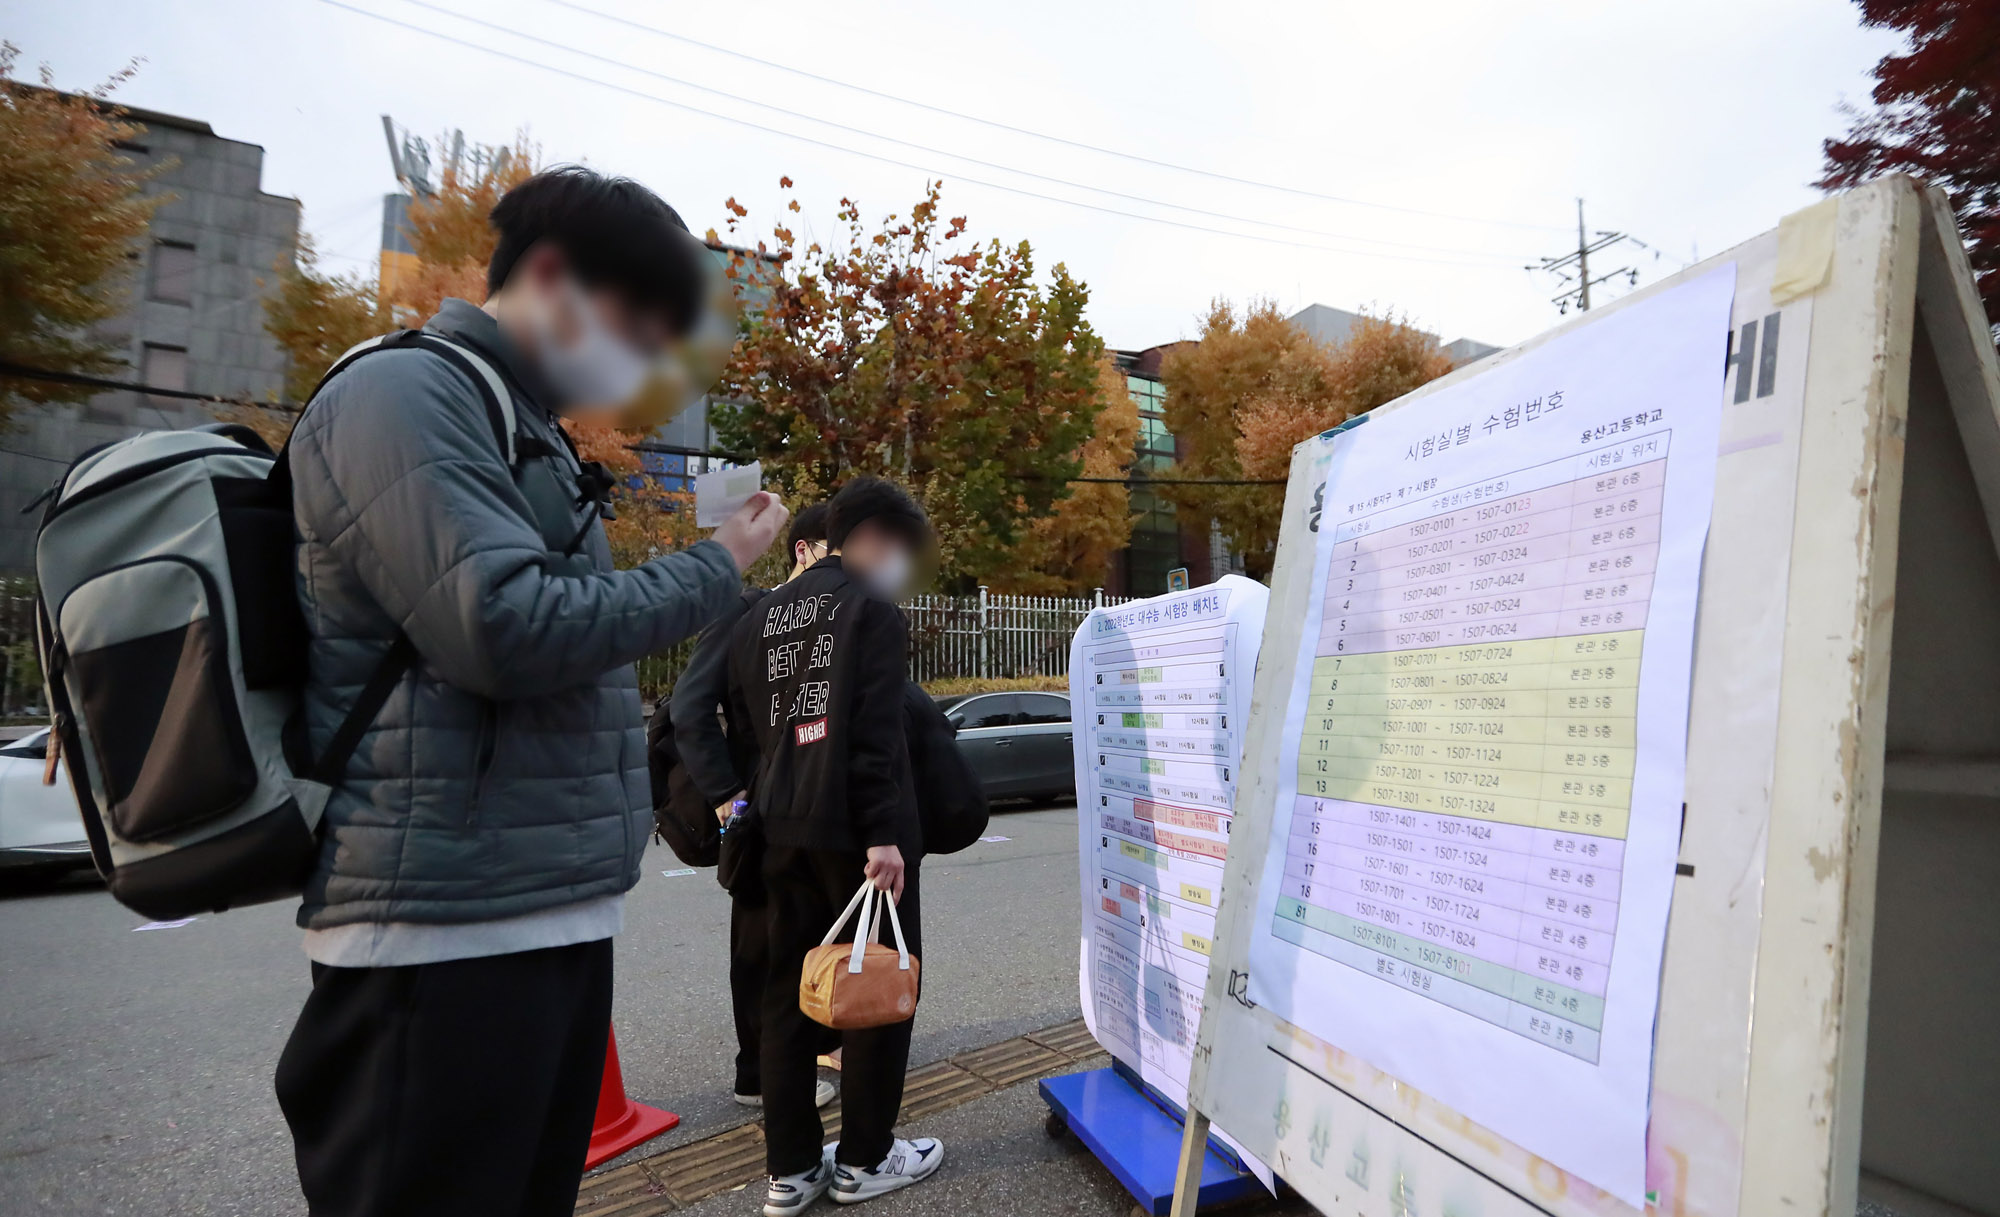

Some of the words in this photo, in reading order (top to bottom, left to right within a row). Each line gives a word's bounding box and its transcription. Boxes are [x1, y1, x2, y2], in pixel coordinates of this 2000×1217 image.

[1405, 423, 1471, 461] 시험실별
[1482, 391, 1564, 435] 수험번호
[1581, 409, 1663, 444] 용산고등학교
[1586, 448, 1624, 468] 시험실
[1632, 440, 1657, 457] 위치
[1354, 542, 1359, 551] 1
[1410, 518, 1454, 536] 1507-0101
[1476, 498, 1531, 522] 1507-0123
[1595, 478, 1617, 492] 본관
[1623, 472, 1640, 486] 6층
[1358, 502, 1364, 511] 15
[1408, 487, 1412, 495] 7
[1347, 580, 1353, 590] 3
[1406, 562, 1451, 579] 1507-0301
[1474, 547, 1527, 567] 1507-0324
[1591, 531, 1613, 545] 본관
[1619, 527, 1636, 539] 6층
[1351, 560, 1356, 571] 2
[1408, 540, 1452, 558] 1507-0201
[1475, 523, 1529, 544] 1507-0222
[1593, 505, 1614, 518] 본관
[1620, 500, 1638, 512] 6층
[1344, 600, 1349, 610] 4
[1403, 585, 1447, 601] 1507-0401
[1470, 573, 1524, 591] 1507-0424
[1588, 560, 1609, 573] 본관
[1615, 556, 1632, 568] 6층
[1105, 613, 1134, 630] 2022학년도
[1138, 608, 1159, 624] 대수능
[1164, 602, 1188, 620] 시험장
[1194, 596, 1219, 615] 배치도
[1338, 640, 1343, 650] 6
[1396, 631, 1440, 645] 1507-0601
[1462, 624, 1517, 639] 1507-0624
[1579, 614, 1600, 627] 본관
[1606, 612, 1623, 624] 6층
[1340, 620, 1346, 631] 5
[1400, 609, 1443, 623] 1507-0501
[1466, 599, 1520, 615] 1507-0524
[1584, 587, 1605, 600] 본관
[1611, 585, 1628, 596] 6층
[768, 634, 834, 681] BETER
[1336, 660, 1341, 671] 7
[1394, 654, 1437, 667] 1507-0701
[1459, 648, 1512, 662] 1507-0724
[1575, 642, 1595, 653] 본관
[1601, 639, 1619, 651] 5층
[1332, 680, 1337, 690] 8
[1391, 676, 1434, 689] 1507-0801
[1456, 673, 1508, 686] 1507-0824
[1571, 669, 1592, 681] 본관
[1598, 667, 1615, 680] 5층
[1327, 699, 1333, 710] 9
[1386, 699, 1432, 710] 1507-0901
[1454, 698, 1505, 710] 1507-0924
[1568, 697, 1589, 709] 본관
[1595, 696, 1612, 709] 5층
[798, 721, 825, 743] HIGHER
[1323, 719, 1333, 730] 10
[1383, 722, 1427, 733] 1507-1001
[1450, 723, 1503, 735] 1507-1024
[1568, 725, 1588, 737] 본관
[1595, 725, 1612, 738] 5층
[1319, 740, 1328, 750] 11
[1380, 744, 1424, 756] 1507-1101
[1447, 747, 1502, 761] 1507-1124
[1565, 754, 1586, 766] 본관
[1592, 754, 1610, 767] 5층
[1317, 760, 1327, 771] 12
[1376, 766, 1421, 779] 1507-1201
[1444, 771, 1499, 787] 1507-1224
[1562, 782, 1583, 795] 본관
[1589, 785, 1606, 797] 5층
[1316, 781, 1326, 792] 13
[1373, 788, 1419, 804] 1507-1301
[1440, 797, 1495, 814] 1507-1324
[1559, 810, 1579, 824] 본관
[1586, 814, 1602, 827] 5층
[1314, 802, 1324, 813] 14
[1370, 811, 1416, 828] 1507-1401
[1437, 821, 1492, 840] 1507-1424
[1554, 839, 1575, 853] 본관
[1581, 844, 1598, 857] 4층
[1312, 822, 1320, 834] 15
[1368, 834, 1413, 852] 1507-1501
[1435, 846, 1488, 867] 1507-1524
[1549, 868, 1571, 883] 본관
[1577, 874, 1595, 887] 4층
[1308, 843, 1317, 855] 16
[1364, 856, 1408, 876] 1507-1601
[1430, 871, 1484, 894] 1507-1624
[1546, 897, 1567, 913] 본관
[1574, 904, 1592, 919] 4층
[1305, 864, 1314, 876] 17
[1360, 879, 1404, 900] 1507-1701
[1426, 896, 1480, 921] 1507-1724
[1542, 927, 1564, 944] 본관
[1569, 934, 1588, 950] 4층
[1301, 885, 1311, 898] 18
[1357, 902, 1400, 925] 1507-1801
[1422, 922, 1476, 948] 1507-1824
[1538, 956, 1559, 974] 본관
[1566, 966, 1583, 981] 4층
[1354, 926, 1396, 950] 1507-8101
[1419, 947, 1471, 976] 1507-8101
[1535, 986, 1555, 1005] 본관
[1562, 997, 1578, 1012] 4층
[1377, 958, 1395, 976] 별도
[1401, 967, 1432, 991] 시험실
[1529, 1017, 1550, 1035] 본관
